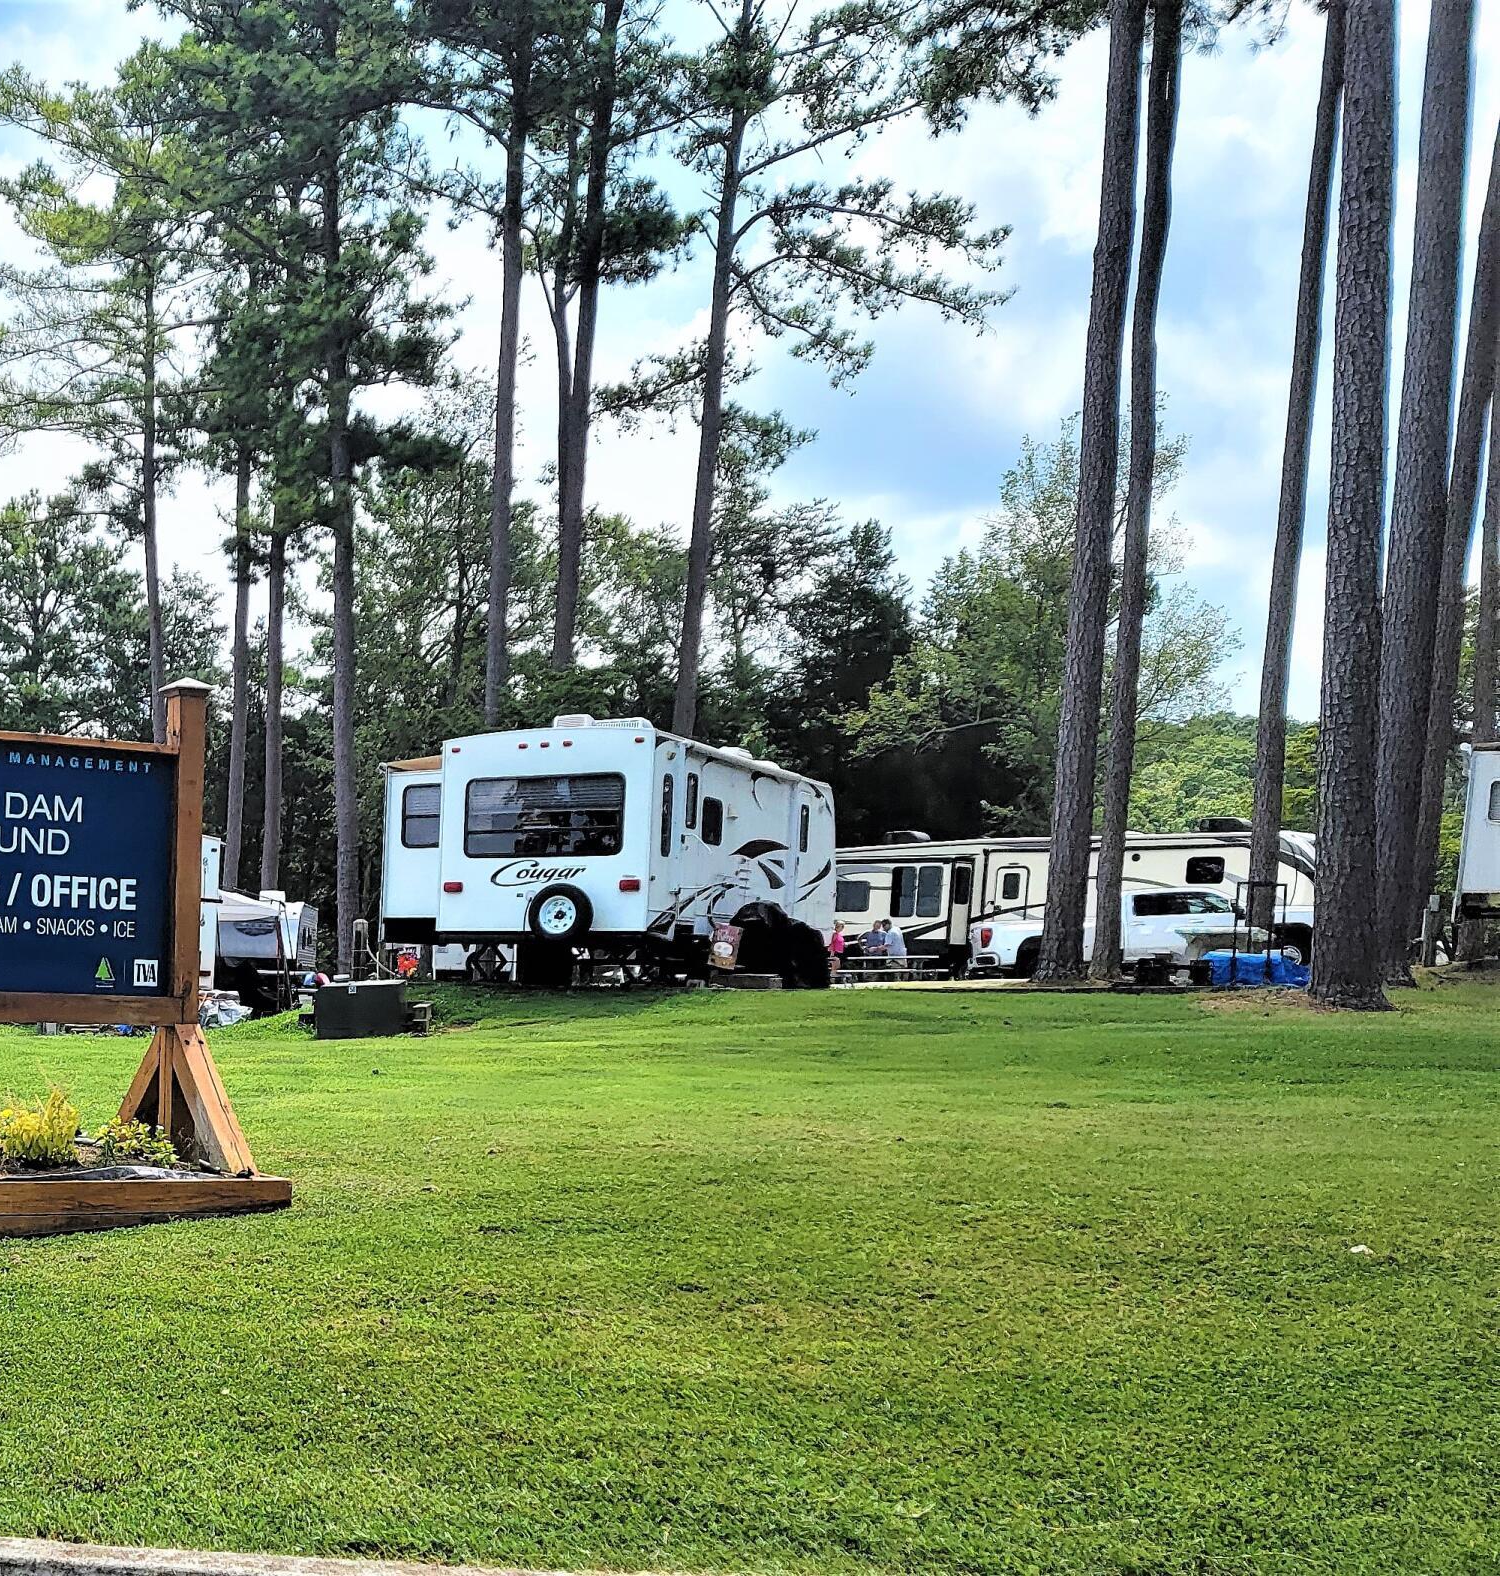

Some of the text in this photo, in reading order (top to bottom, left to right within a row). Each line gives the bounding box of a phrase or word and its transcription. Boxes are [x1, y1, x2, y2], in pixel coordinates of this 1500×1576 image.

[9, 751, 152, 774] MANAGEMENT
[5, 791, 83, 823] DAM
[490, 859, 587, 887] Cougar
[31, 873, 137, 911] OFFICE
[36, 917, 95, 937] SNACKS
[113, 920, 135, 938] ICE
[135, 963, 157, 983] TVA
